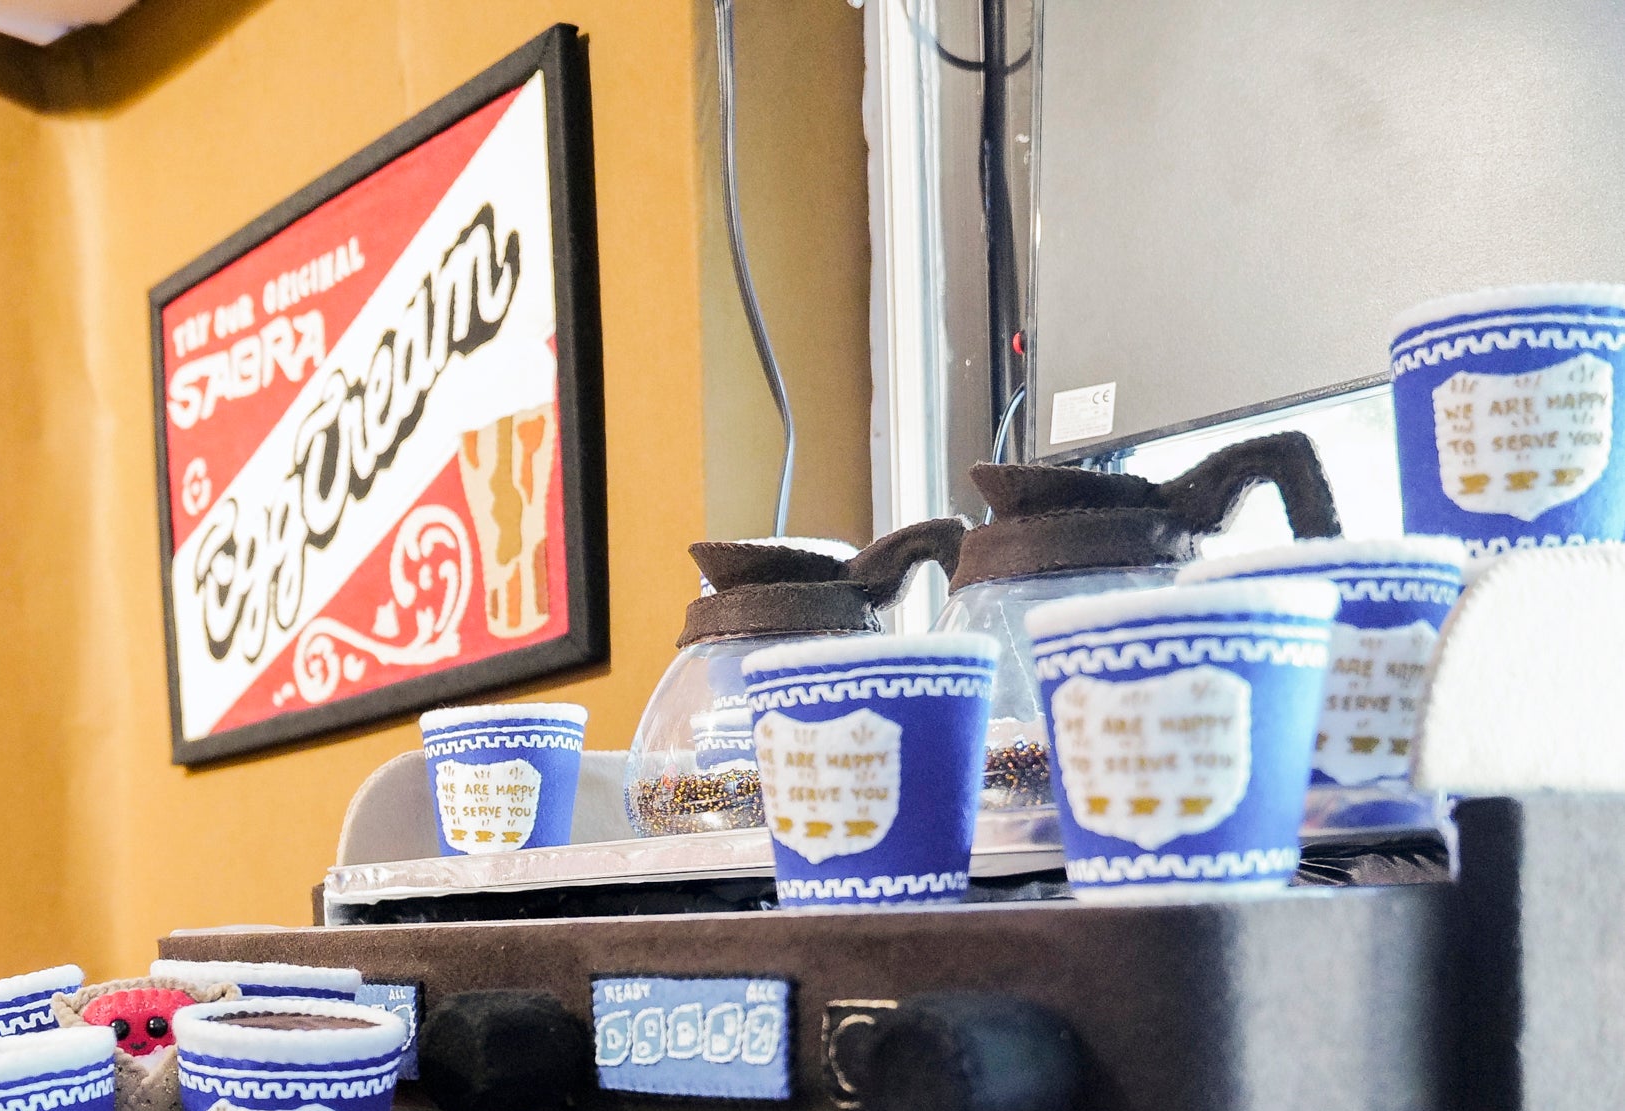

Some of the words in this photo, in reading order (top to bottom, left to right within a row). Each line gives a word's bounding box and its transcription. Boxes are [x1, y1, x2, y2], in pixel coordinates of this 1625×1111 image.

[173, 310, 212, 358] TRY
[214, 294, 255, 339] OUR
[263, 236, 365, 314] ORIGINAL
[167, 309, 326, 429] SABRA
[286, 202, 520, 549] Cream
[1489, 397, 1534, 416] ARE
[1447, 440, 1475, 455] TO
[1492, 431, 1559, 450] SERVE
[785, 752, 815, 768] ARE
[826, 752, 889, 769] HAPPY
[442, 783, 456, 795] WE
[464, 783, 489, 795] ARE
[496, 784, 535, 798] HAPPY
[851, 787, 889, 801] YOU
[444, 805, 456, 816] TO
[462, 805, 501, 818] SERVE
[507, 807, 531, 818] YOU
[389, 988, 406, 1001] ALL
[604, 982, 651, 1004] READY
